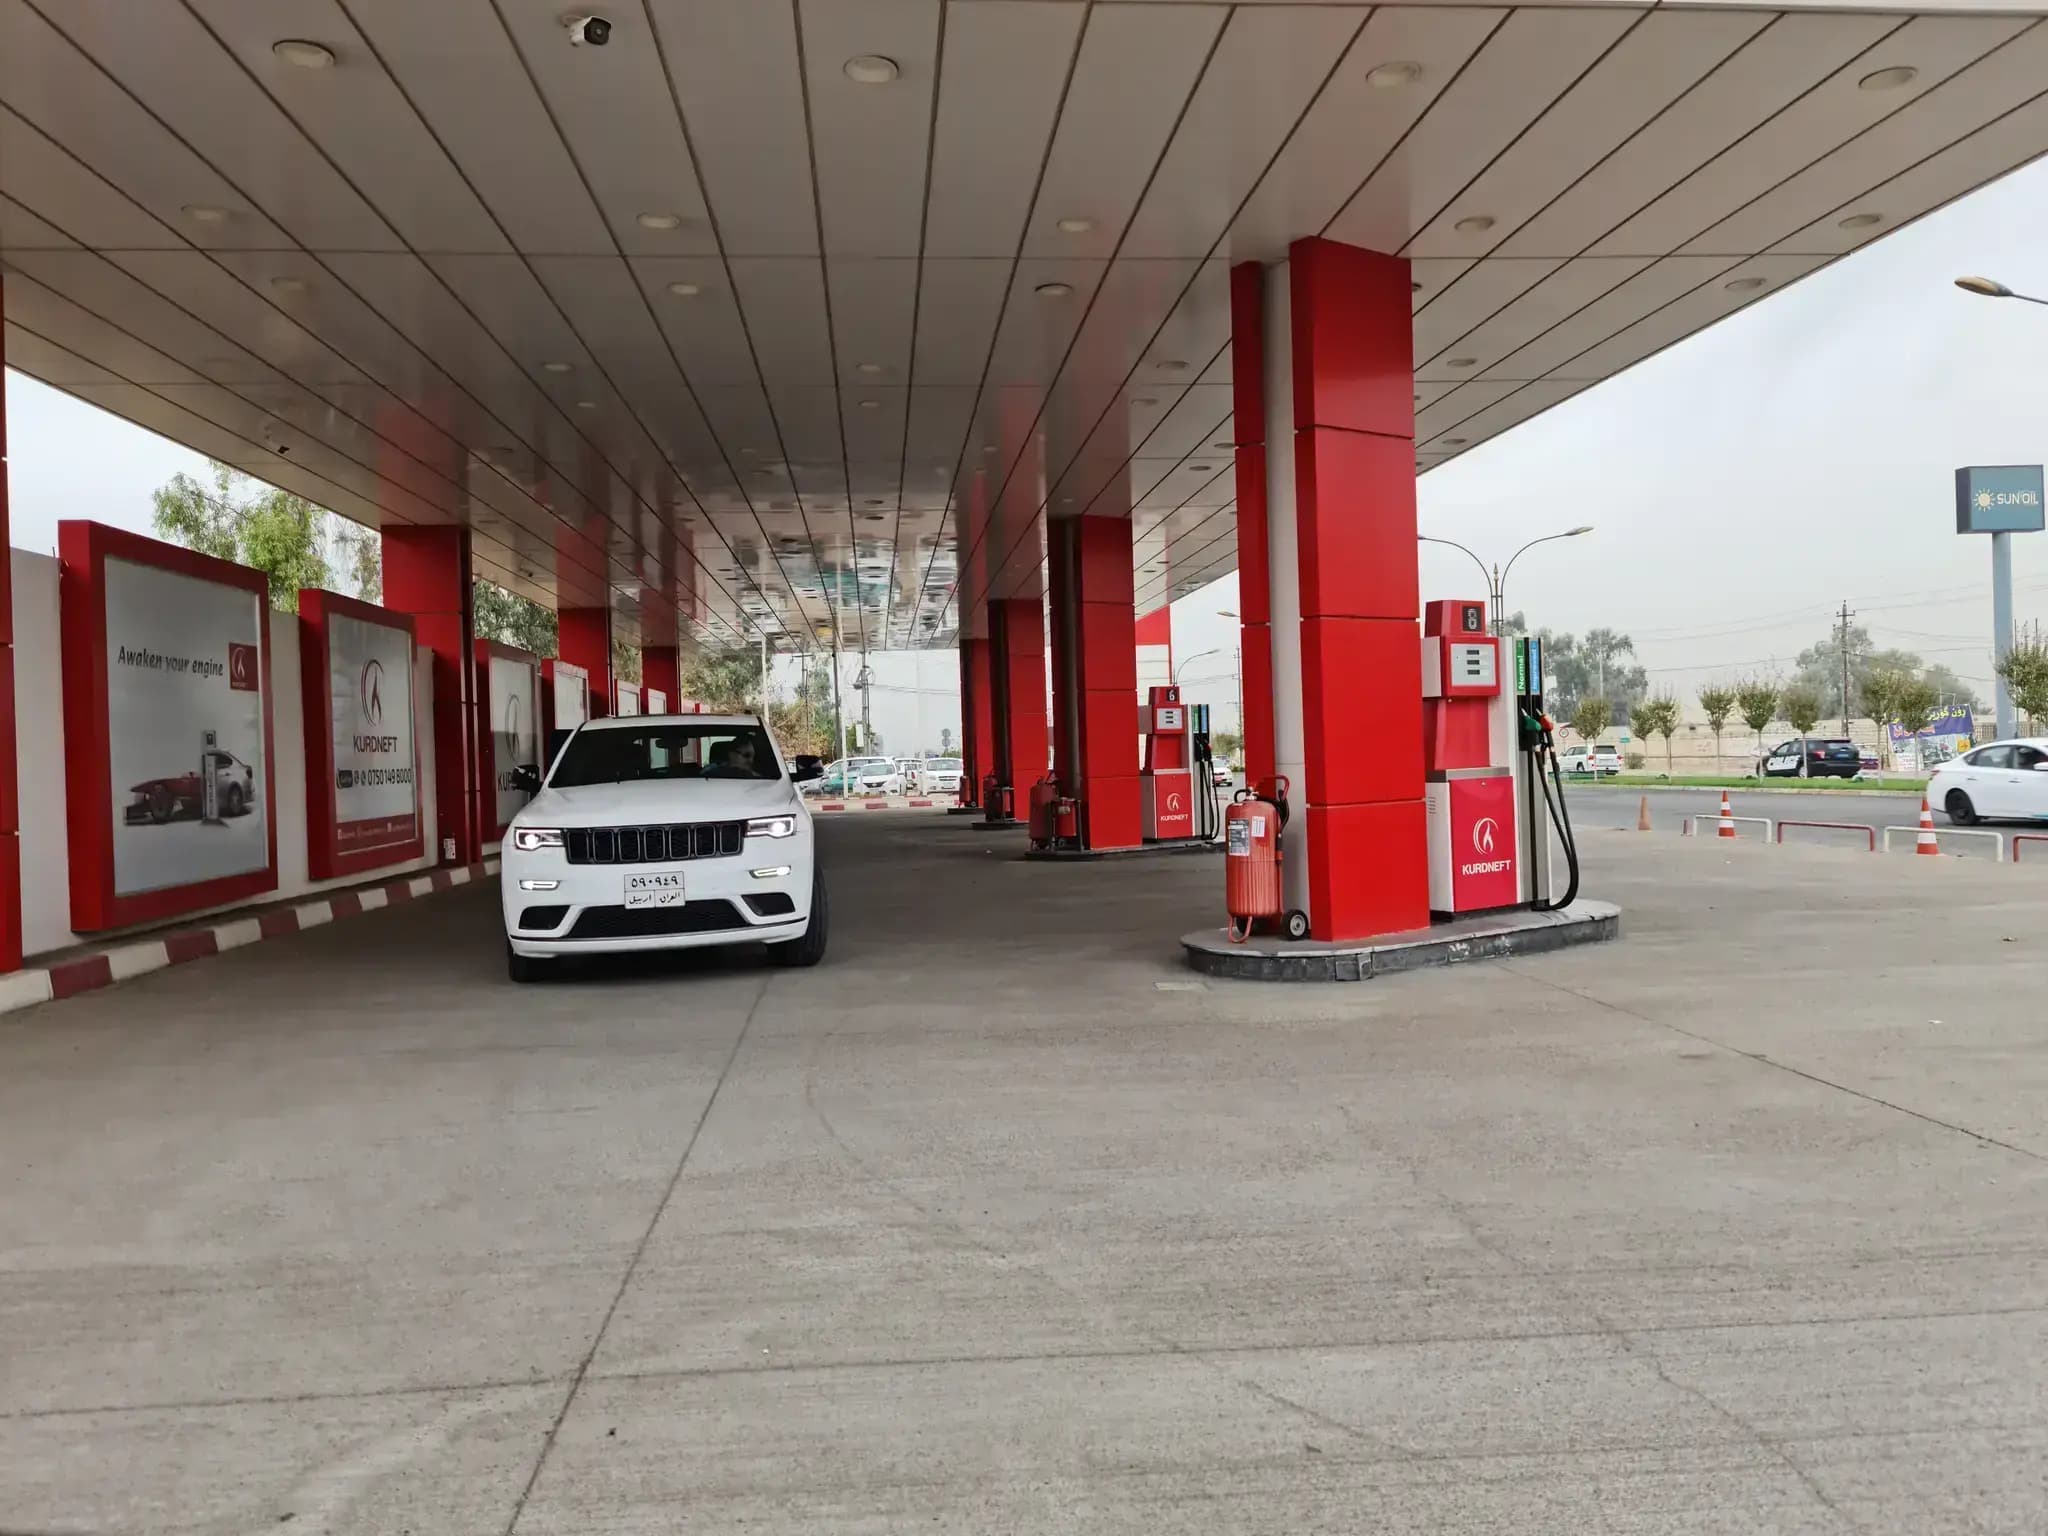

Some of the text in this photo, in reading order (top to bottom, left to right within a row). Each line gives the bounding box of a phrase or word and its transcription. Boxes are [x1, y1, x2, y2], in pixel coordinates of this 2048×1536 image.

[1997, 492, 2020, 505] SUN
[118, 645, 224, 679] Awaken your engine
[1517, 655, 1525, 690] Normal
[1168, 689, 1176, 701] 6
[353, 735, 398, 753] KURDNEFT
[1160, 813, 1189, 822] KURDNEFT
[1462, 859, 1512, 876] KURDNEFT
